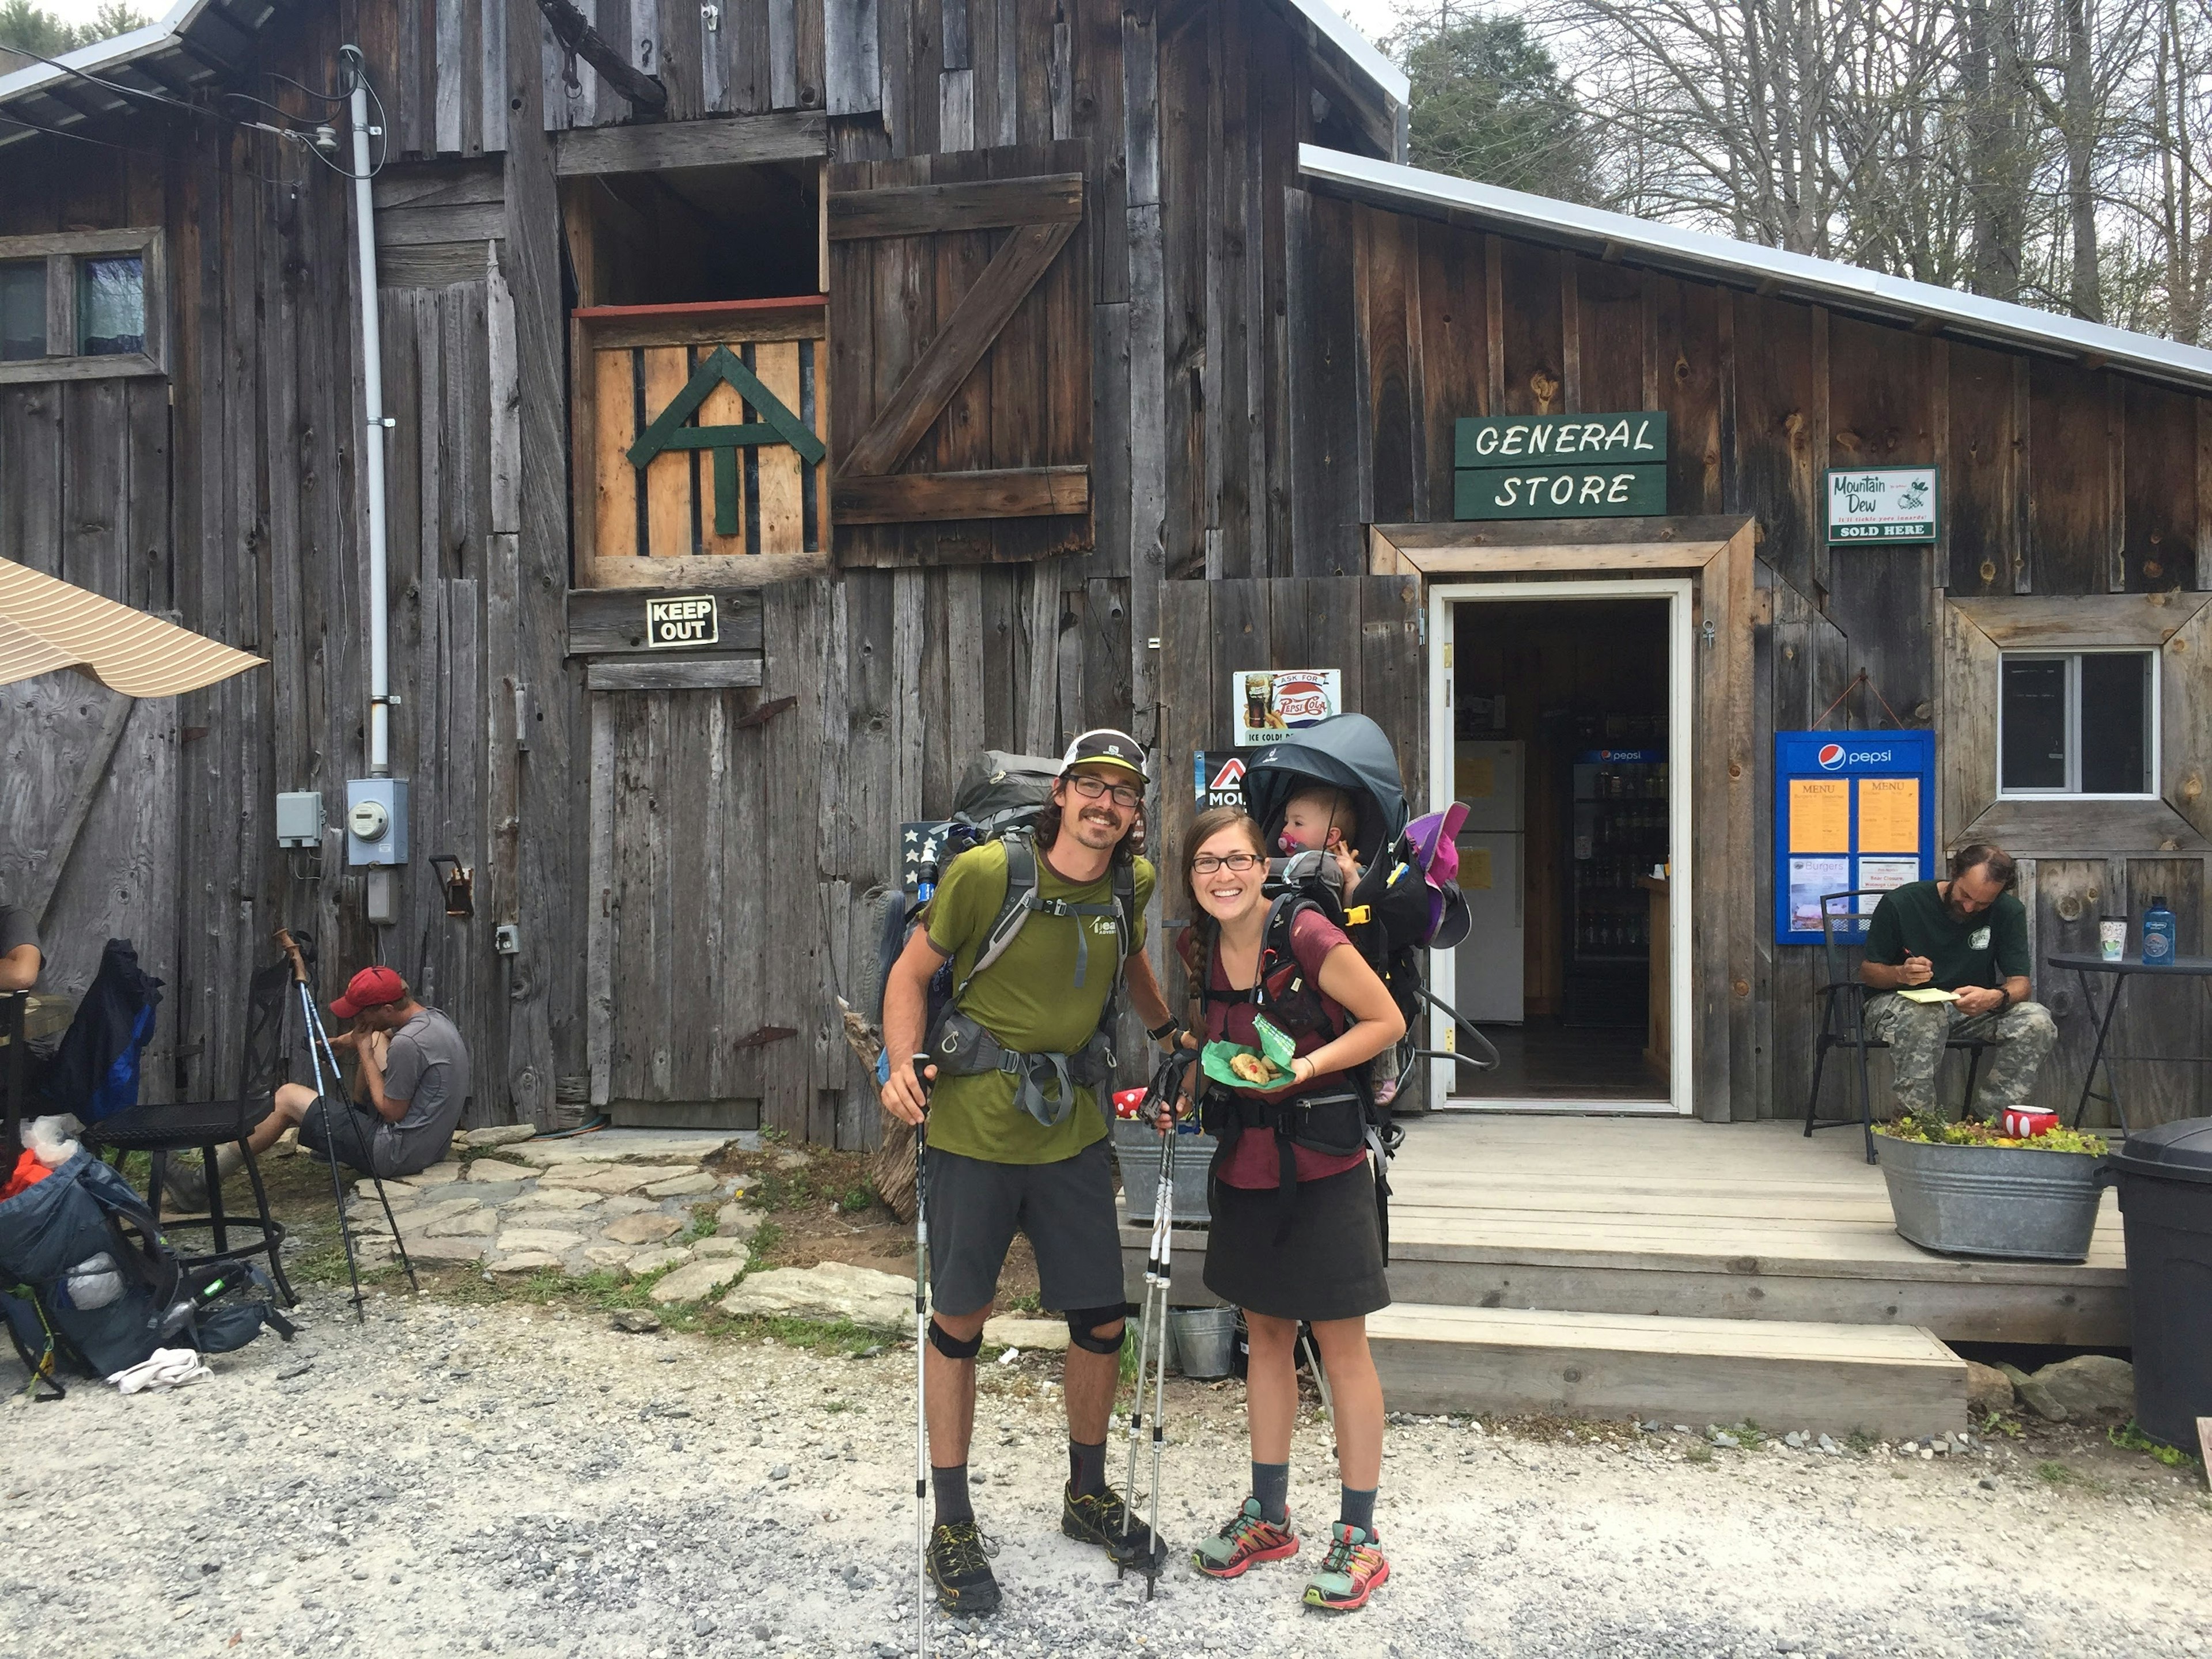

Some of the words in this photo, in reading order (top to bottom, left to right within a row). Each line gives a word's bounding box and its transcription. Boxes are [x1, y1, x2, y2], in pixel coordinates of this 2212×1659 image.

[1476, 419, 1654, 456] GENERAL
[1494, 474, 1636, 506] STORE
[1834, 475, 1885, 495] Mountain
[1845, 494, 1876, 513] Dew
[1840, 527, 1880, 537] SOLD
[1884, 525, 1925, 536] HERE
[653, 601, 712, 622] KEEP
[660, 620, 706, 641] OUT
[1281, 675, 1297, 684] ASK
[1302, 675, 1318, 683] FOR
[1249, 733, 1259, 741] ICE
[1262, 733, 1282, 741] COLD!
[1613, 751, 1641, 761] pepsi
[1849, 749, 1891, 764] pepsi
[1802, 785, 1835, 793] MENU
[1872, 782, 1904, 791] MENU
[1805, 861, 1843, 872] Burgers
[1094, 921, 1116, 934] pea
